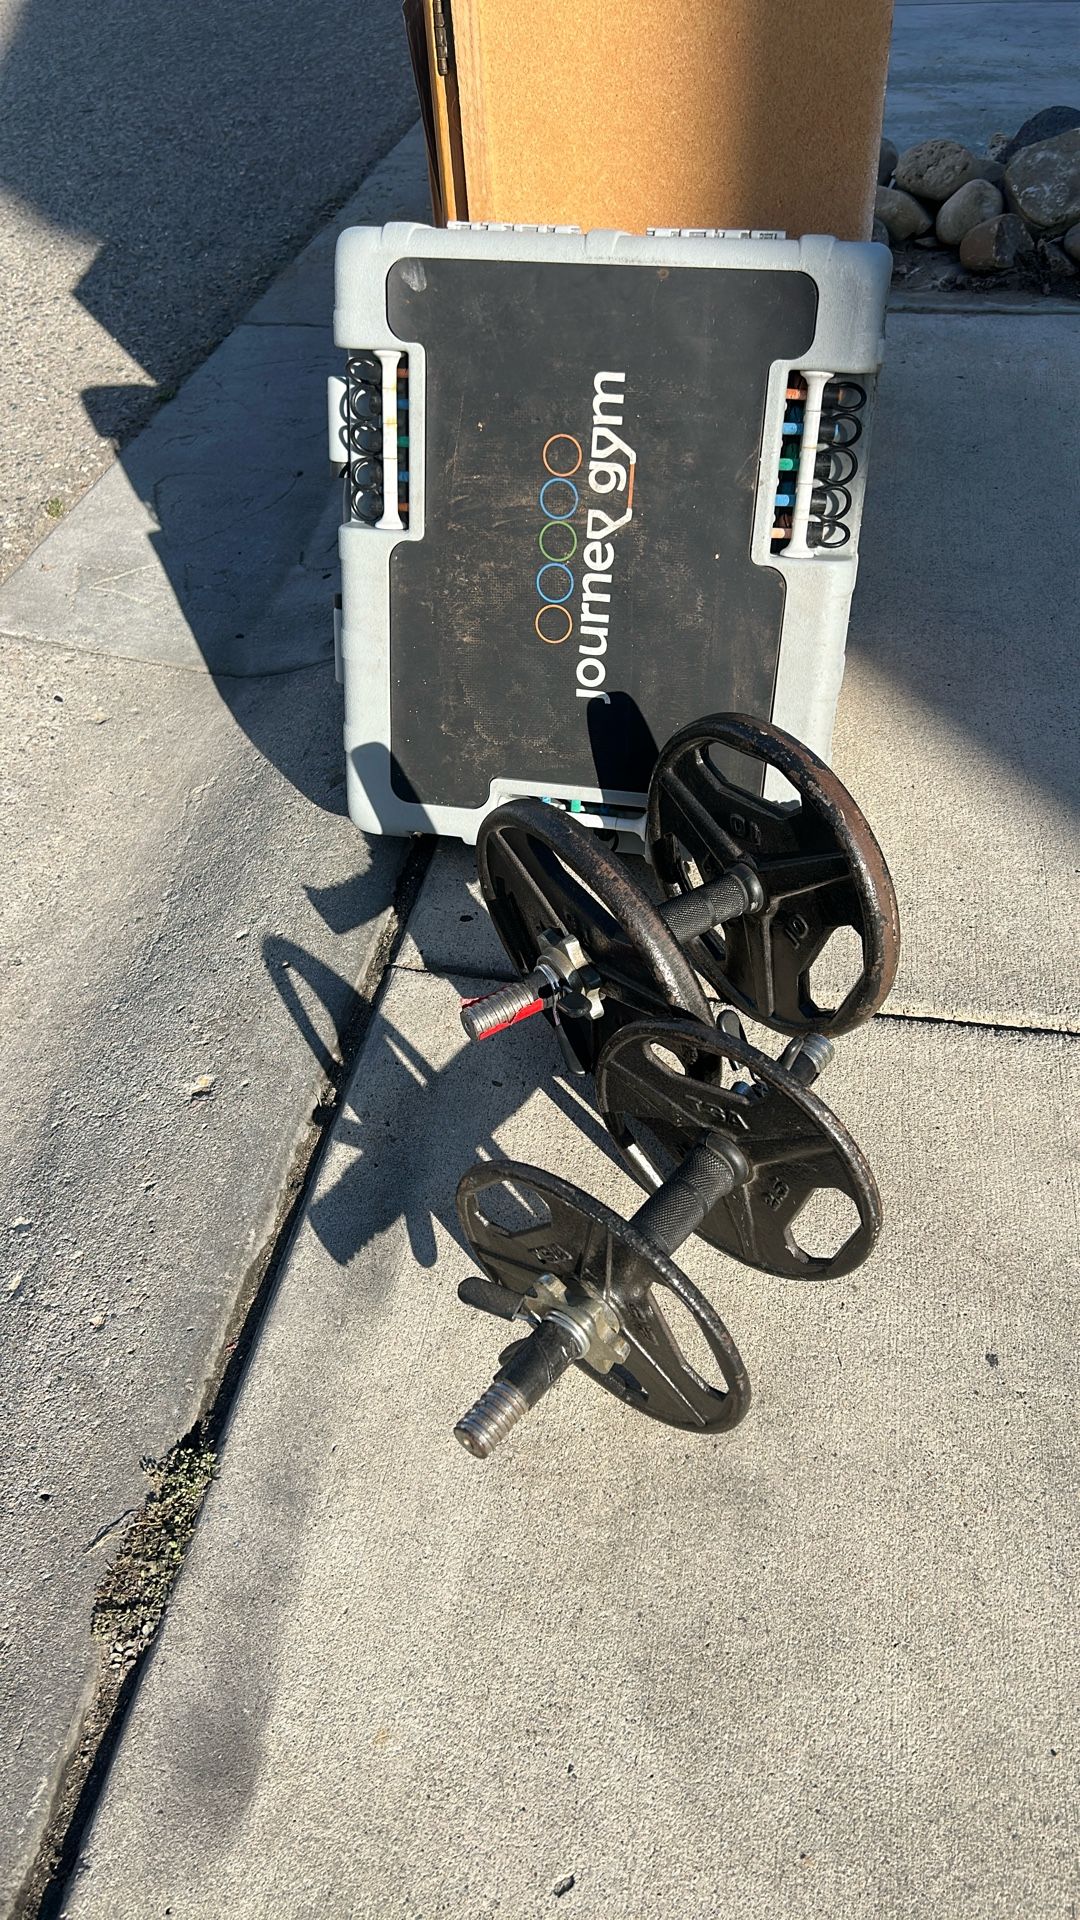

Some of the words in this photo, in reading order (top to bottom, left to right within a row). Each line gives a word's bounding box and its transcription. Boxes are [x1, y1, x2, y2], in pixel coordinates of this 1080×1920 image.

[588, 371, 637, 494] gym
[575, 508, 633, 704] journey
[784, 914, 809, 950] 10
